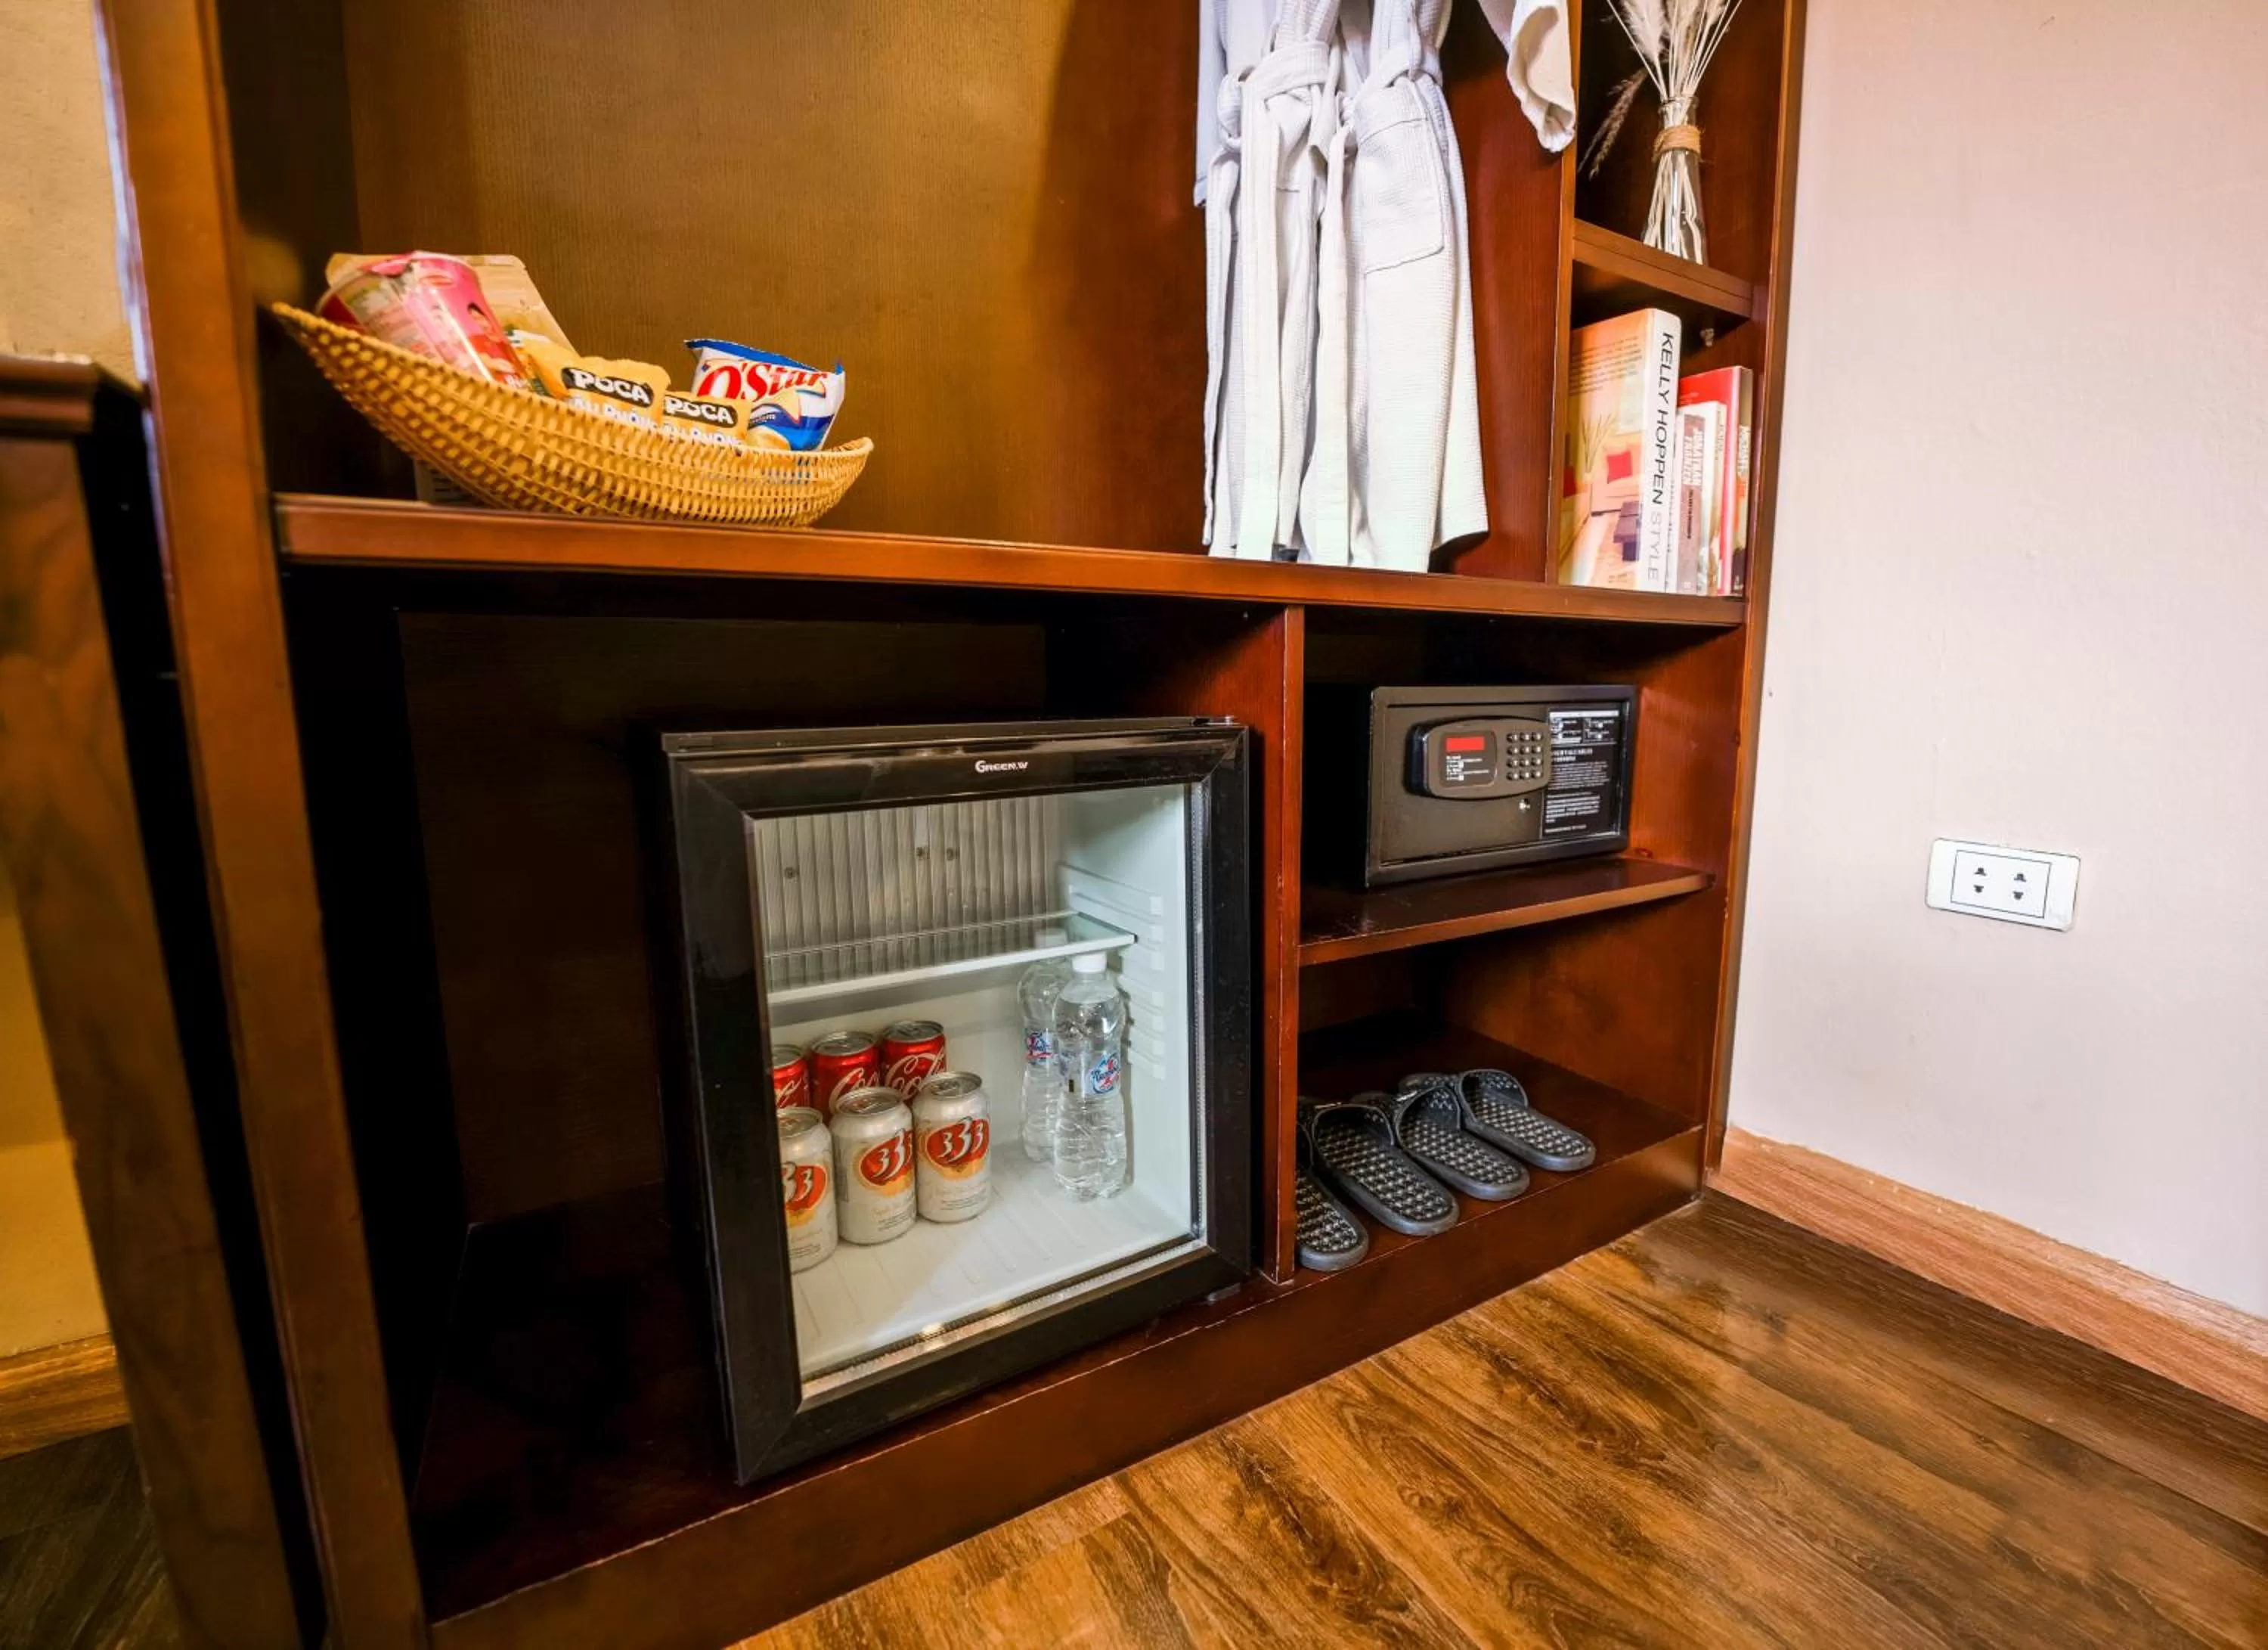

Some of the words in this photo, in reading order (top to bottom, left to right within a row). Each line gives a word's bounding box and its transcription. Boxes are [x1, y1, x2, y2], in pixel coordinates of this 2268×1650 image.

[570, 368, 650, 405] POCA
[1658, 332, 1674, 407] KELLY
[665, 395, 734, 425] POCA
[1652, 410, 1671, 505] HOPPEN
[1647, 510, 1664, 582] STYLE
[936, 1117, 984, 1165] 333
